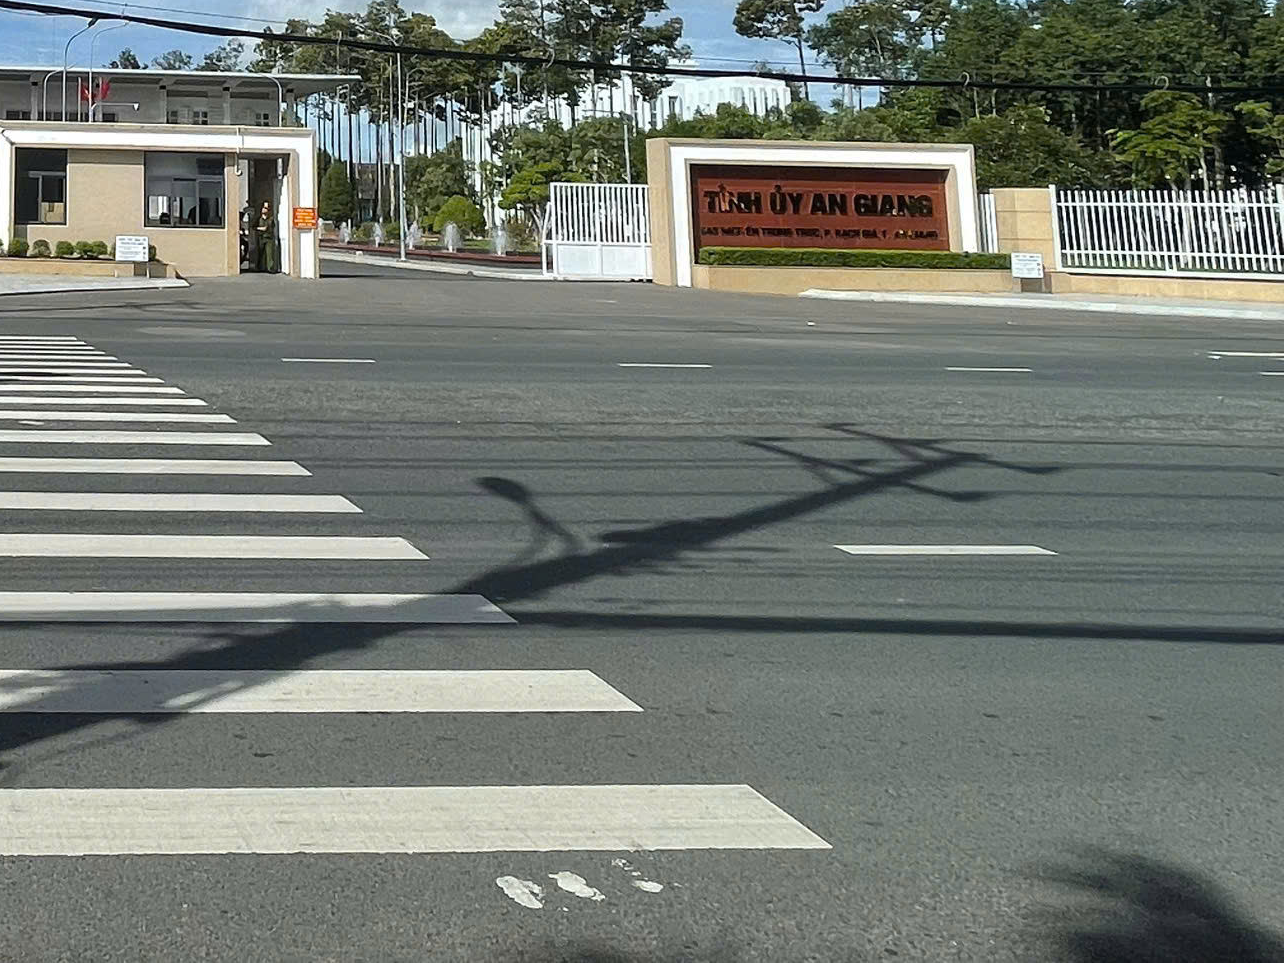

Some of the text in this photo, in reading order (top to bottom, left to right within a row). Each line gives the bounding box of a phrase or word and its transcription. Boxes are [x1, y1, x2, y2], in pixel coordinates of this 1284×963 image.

[703, 183, 934, 218] TỈNH ỦY AN GIANG
